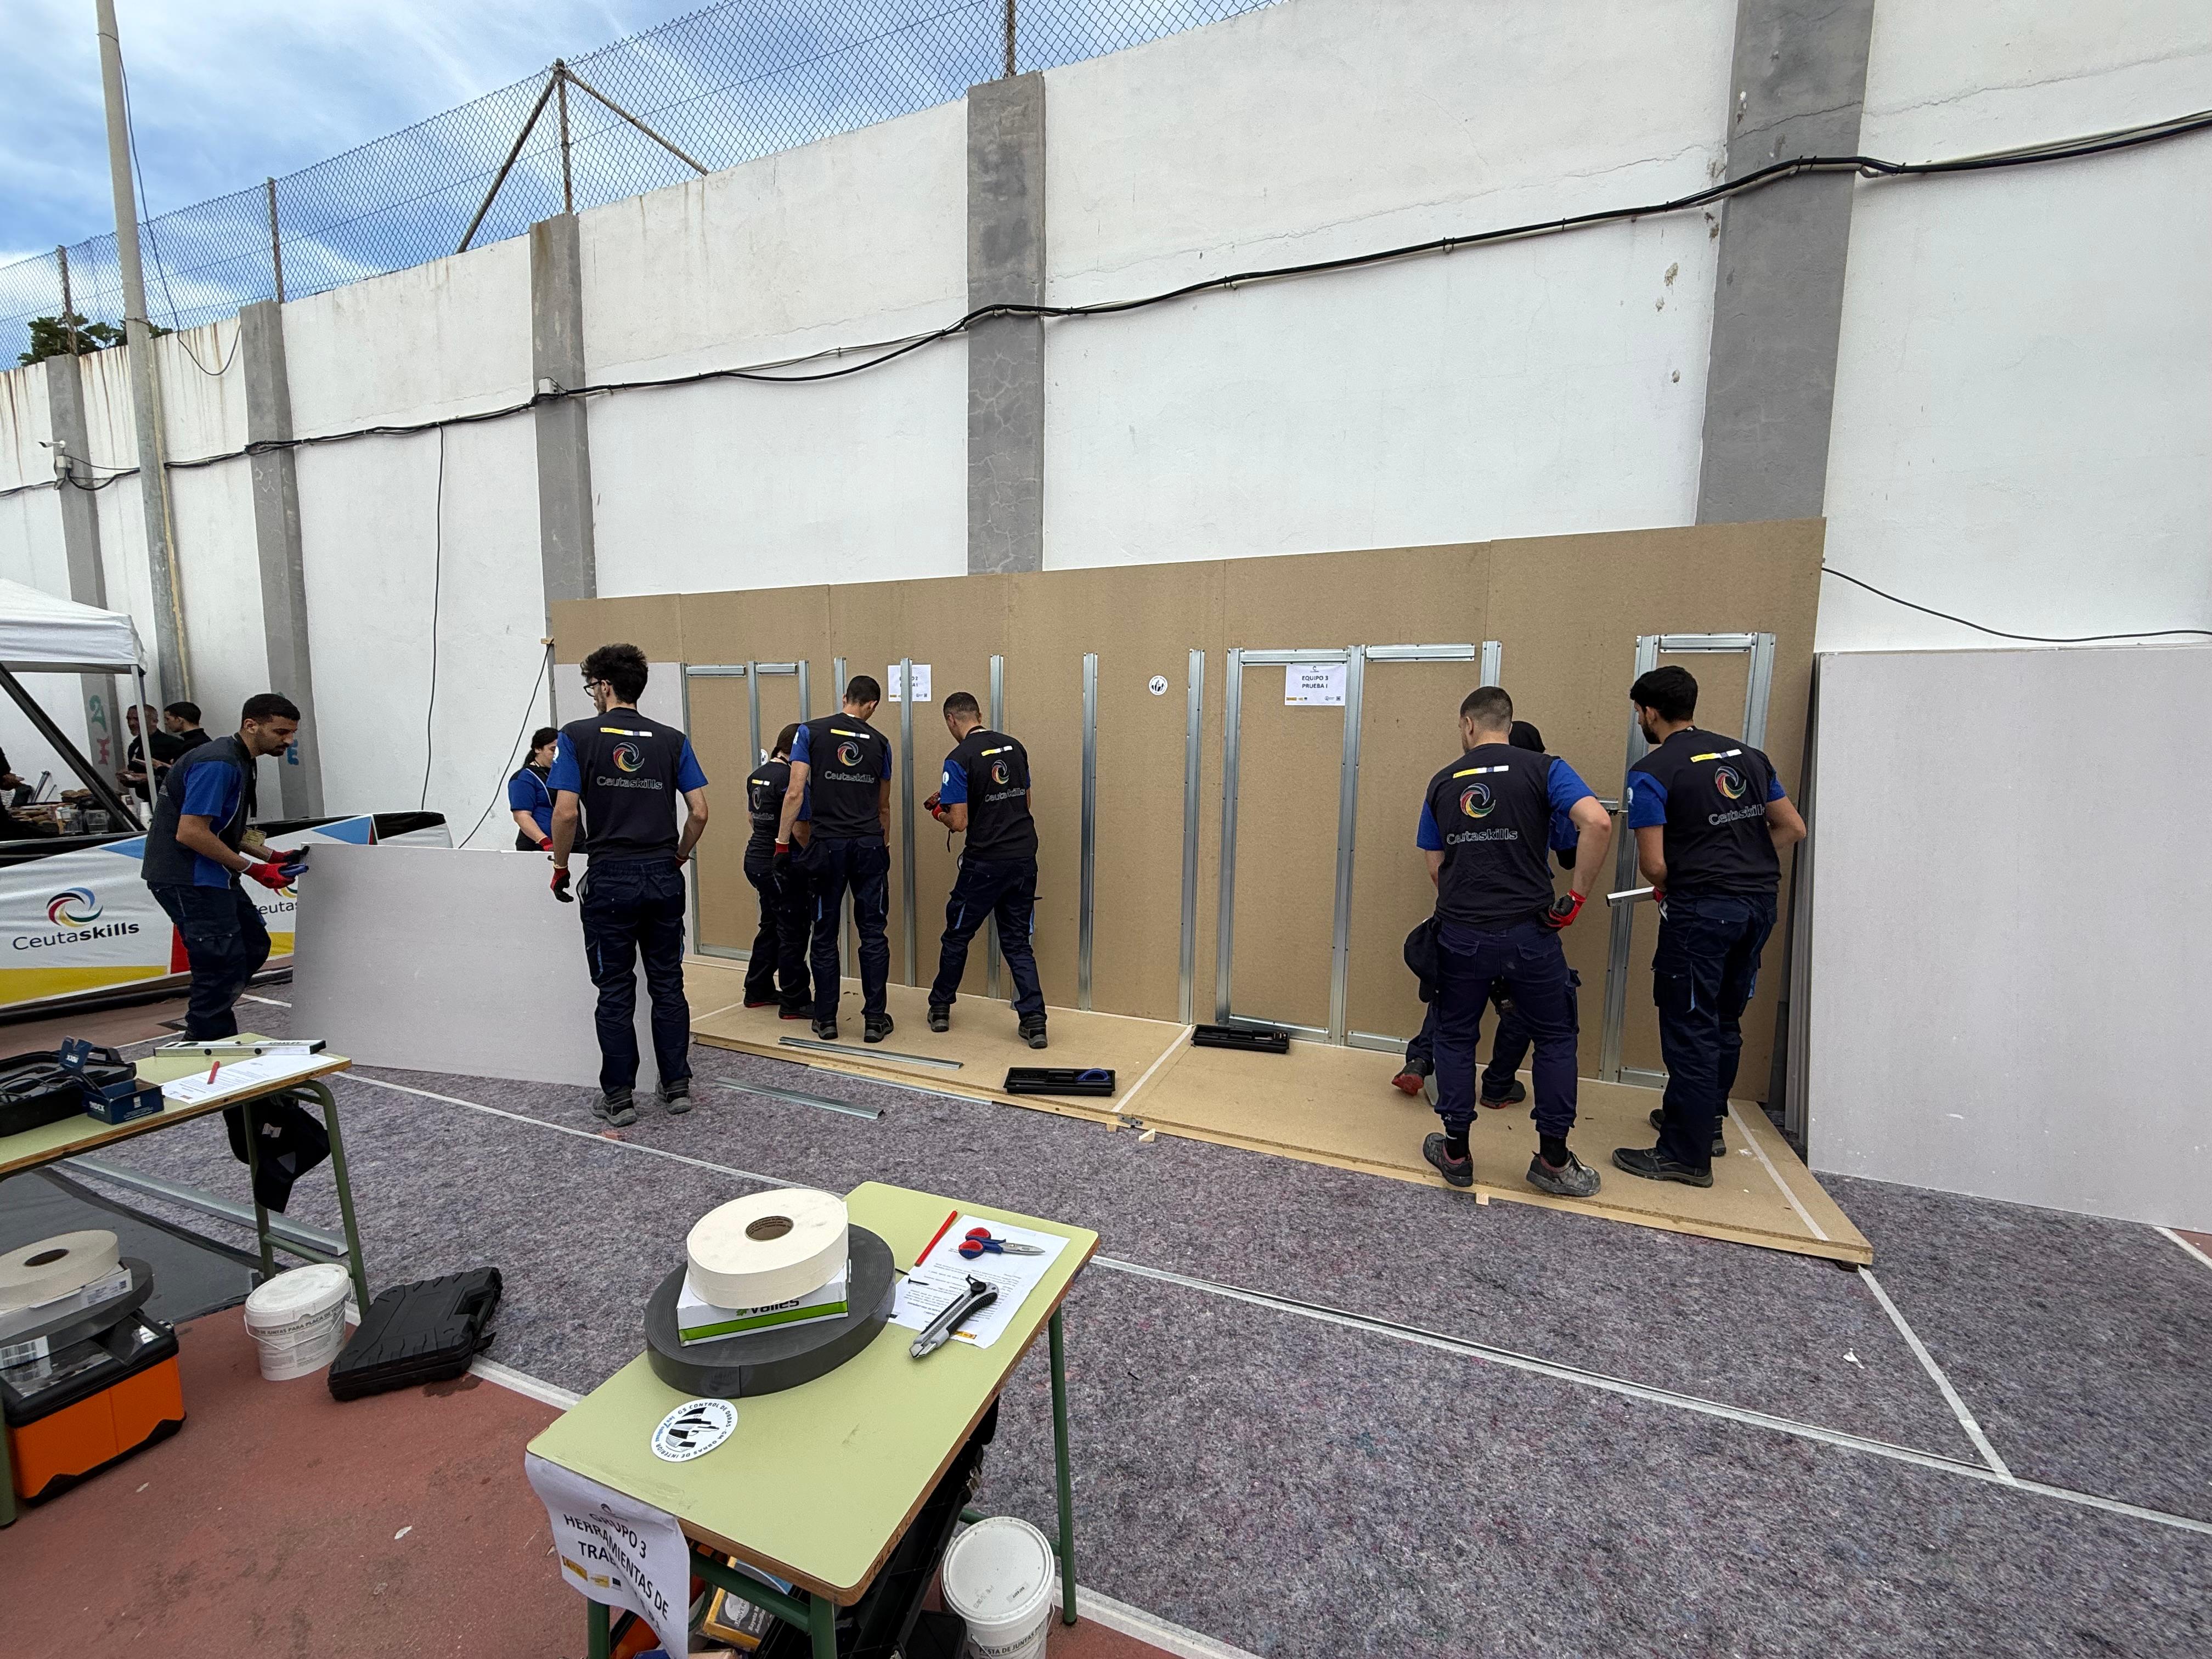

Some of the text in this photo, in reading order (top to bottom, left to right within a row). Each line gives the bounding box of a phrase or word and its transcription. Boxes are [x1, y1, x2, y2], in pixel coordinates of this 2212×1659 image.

[597, 776, 663, 789] Ceutaskills
[1447, 828, 1518, 844] Ceutaskills
[12, 922, 140, 950] Ceutaskills
[306, 1316, 323, 1326] PLACA
[656, 1443, 679, 1458] INTERIOR
[693, 1440, 717, 1455] OBRAS
[589, 1513, 646, 1559] GRUPO 3
[563, 1514, 653, 1599] HERRAMIENTAS
[654, 1590, 669, 1621] DE
[1012, 1632, 1034, 1650] JUNTAS
